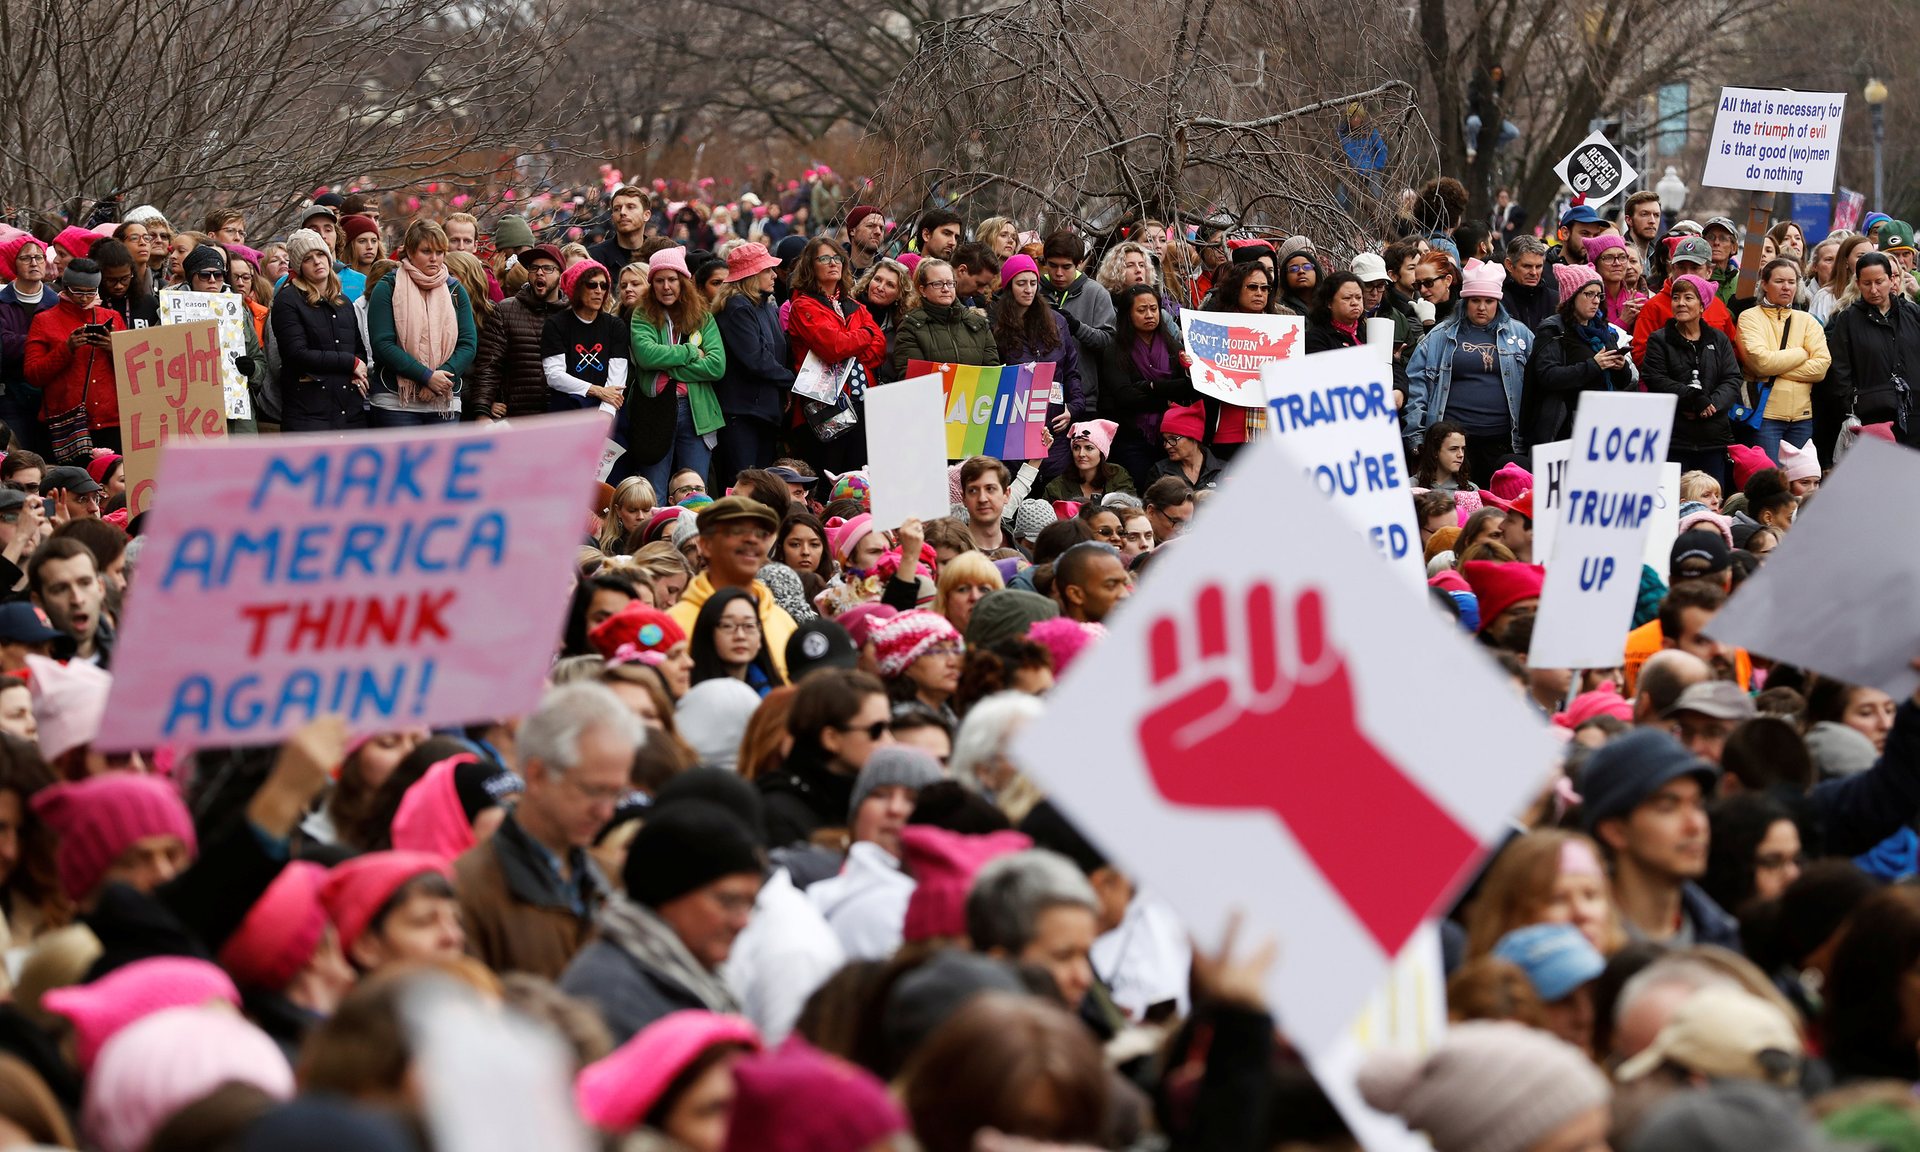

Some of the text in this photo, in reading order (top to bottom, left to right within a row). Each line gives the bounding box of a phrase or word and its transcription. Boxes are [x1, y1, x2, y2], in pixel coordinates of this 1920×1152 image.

[1721, 97, 1841, 120] All that is necessary for
[1733, 120, 1827, 141] the triumph of evil
[1586, 147, 1619, 181] RESPECT
[1721, 140, 1830, 163] is that good (wo)men
[1746, 164, 1803, 185] do nothing
[1190, 331, 1258, 351] DON'T MOURN
[125, 326, 221, 408] Fight
[1587, 426, 1660, 464] LOCK
[251, 439, 494, 510] MAKE
[1305, 450, 1400, 497] OU'RE
[1568, 489, 1654, 529] TRUMP
[161, 509, 508, 592] AMERICA
[1579, 556, 1615, 592] UP
[239, 588, 457, 658] THINK
[162, 658, 435, 736] AGAIN!
